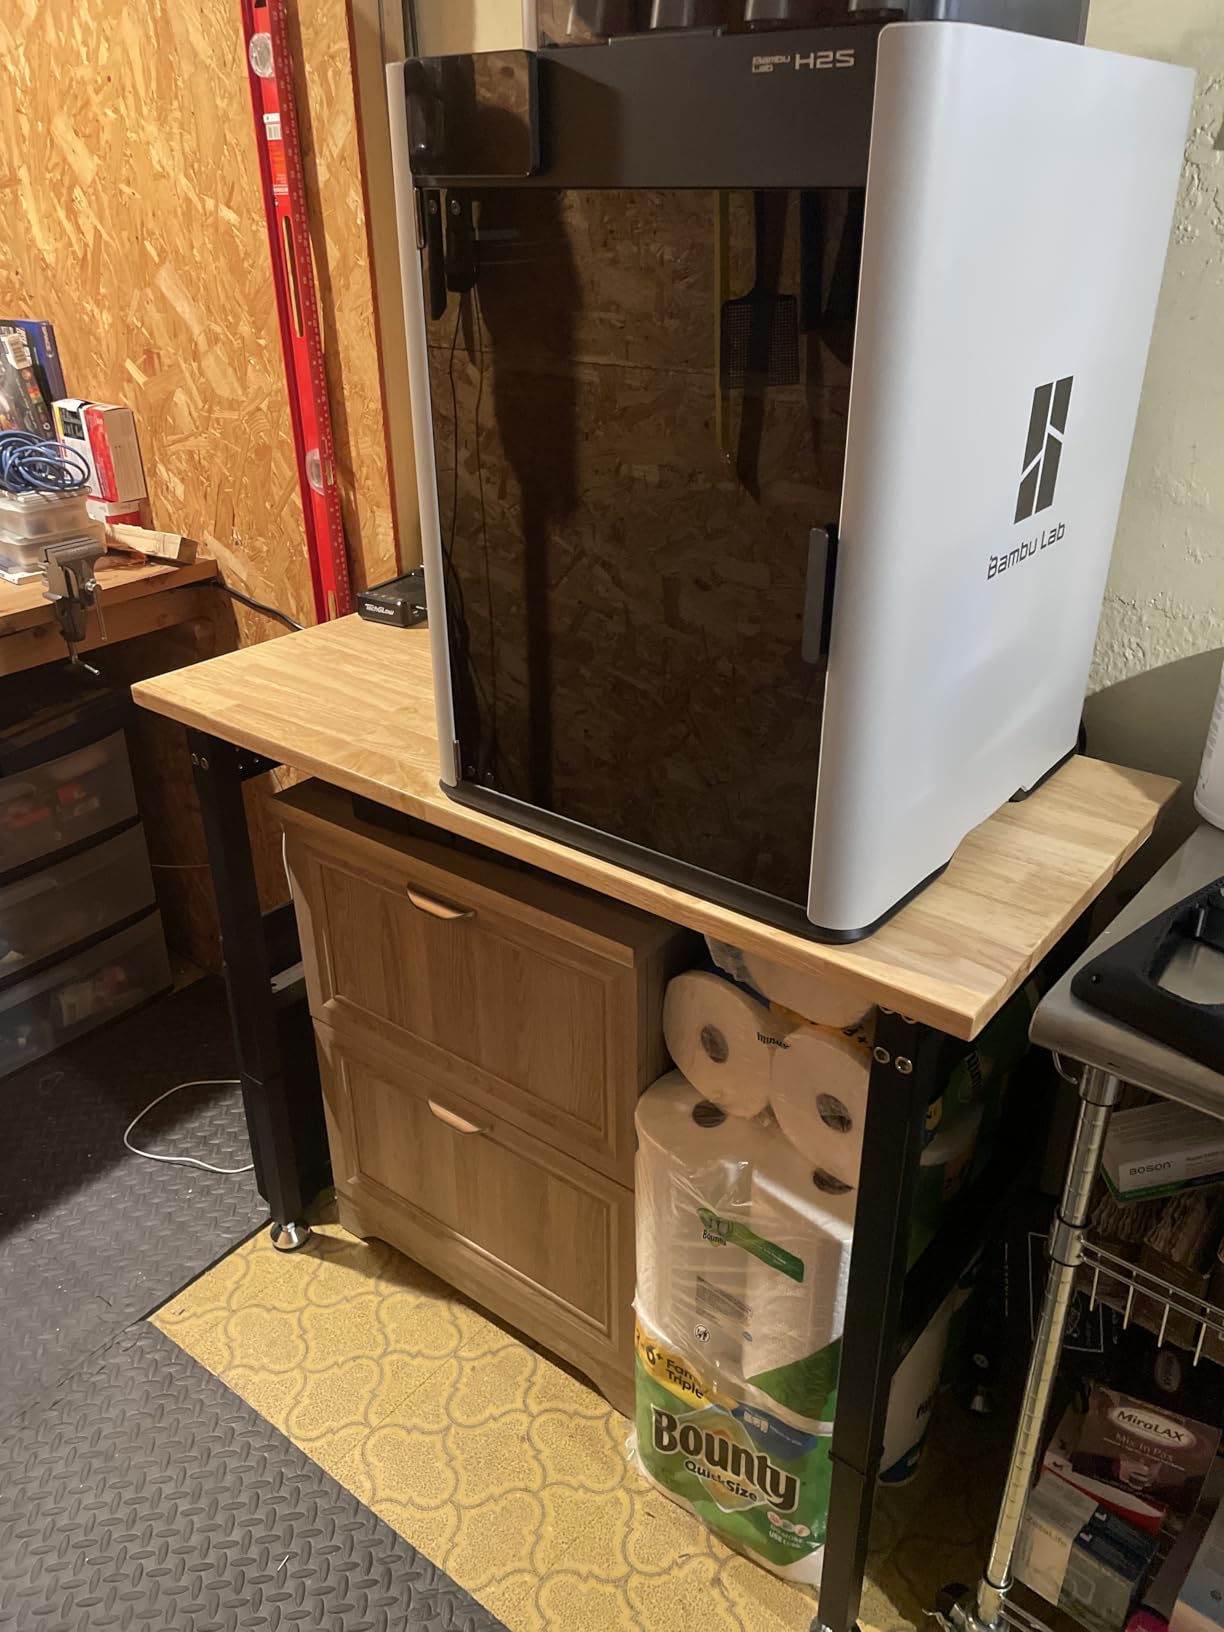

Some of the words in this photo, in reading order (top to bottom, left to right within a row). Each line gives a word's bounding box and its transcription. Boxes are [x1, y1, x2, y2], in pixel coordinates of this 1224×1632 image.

[795, 50, 855, 71] H2S
[988, 538, 1038, 580] Bambu
[1040, 521, 1065, 550] Lab
[666, 1368, 704, 1400] Triple
[1117, 1410, 1184, 1442] MiraLAX
[652, 1407, 799, 1512] Bounty
